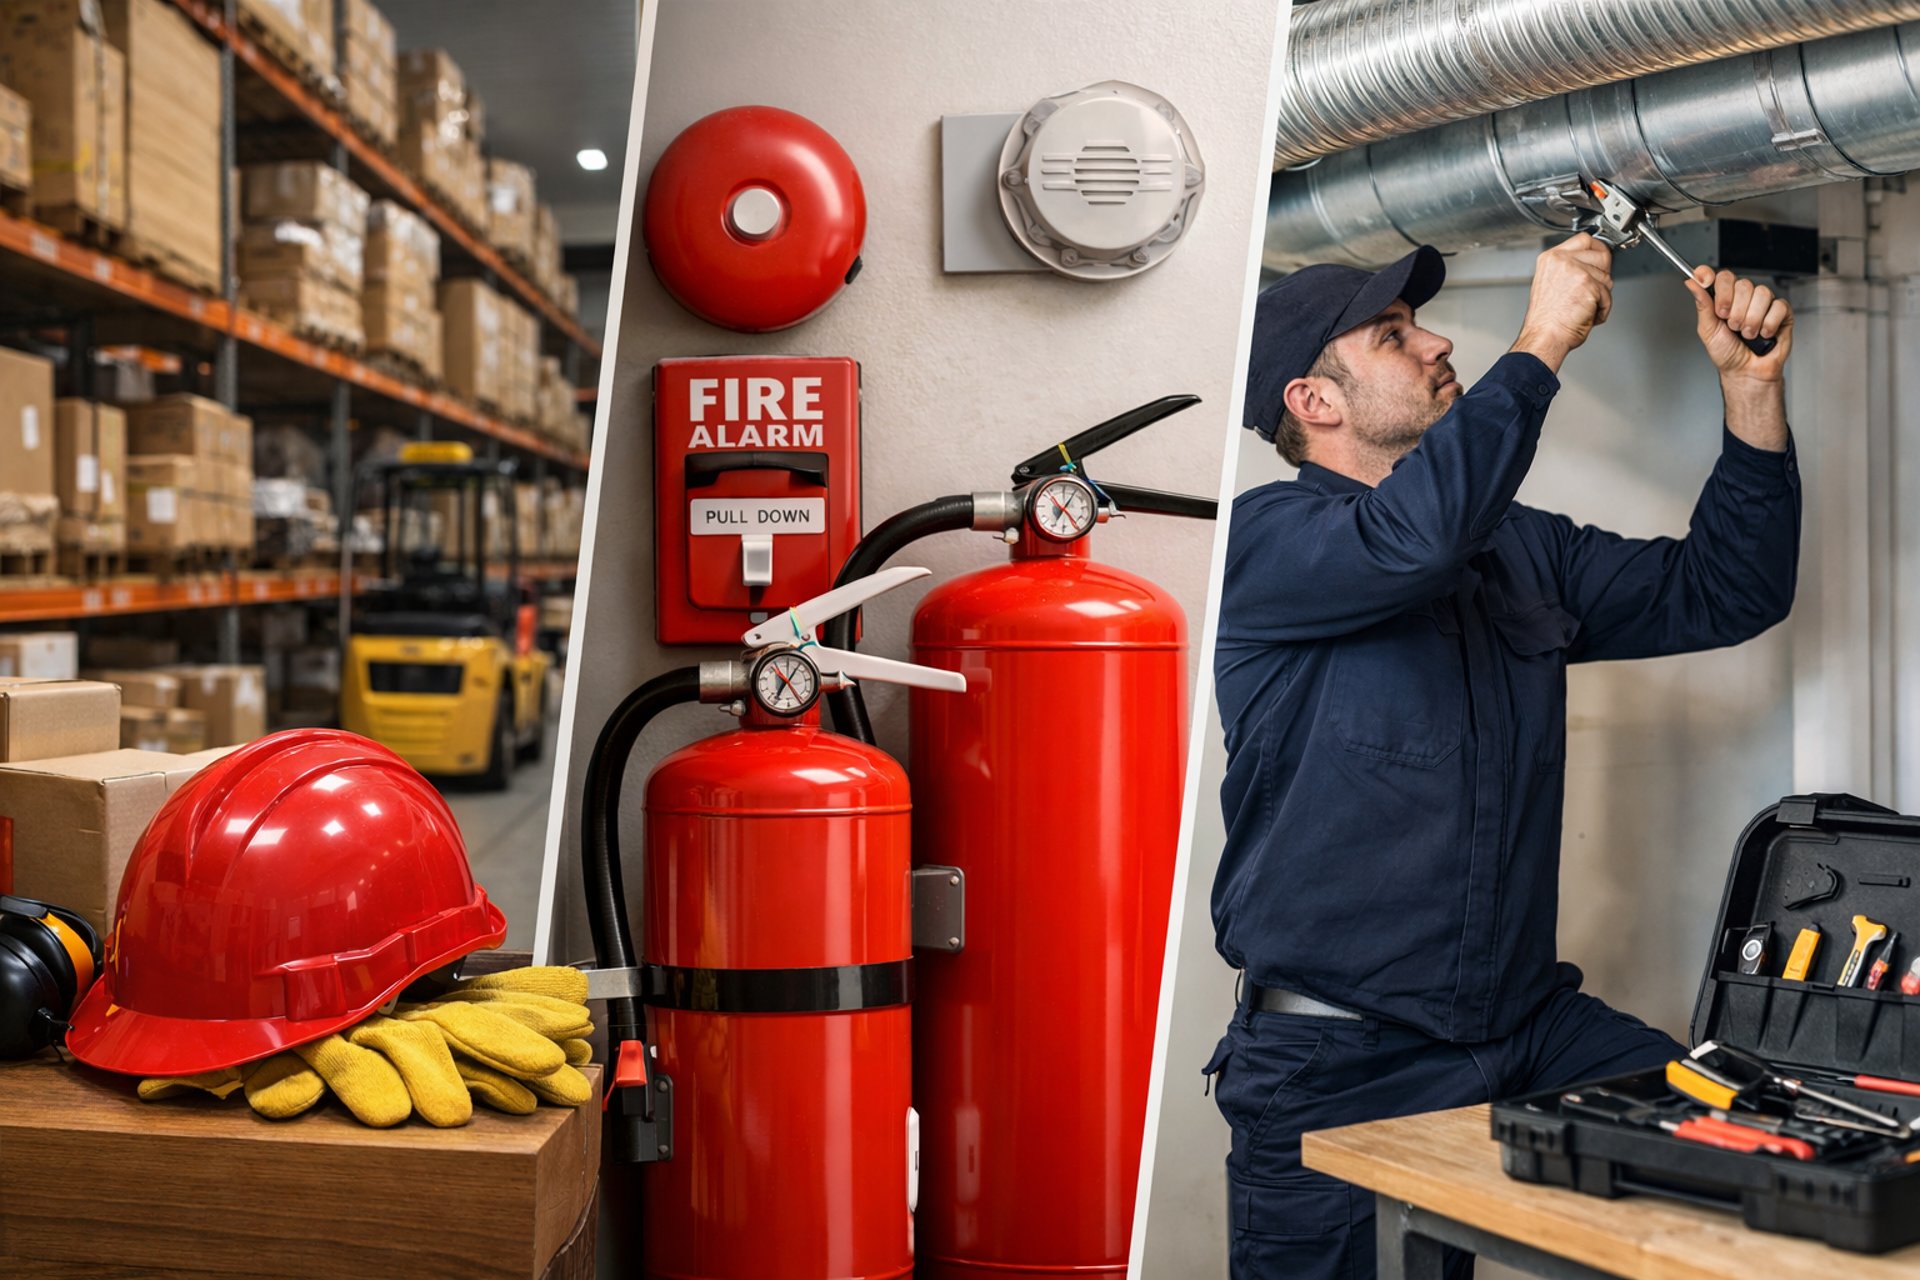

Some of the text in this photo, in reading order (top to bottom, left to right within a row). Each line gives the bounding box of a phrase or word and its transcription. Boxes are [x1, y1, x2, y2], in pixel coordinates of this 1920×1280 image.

[689, 377, 823, 422] FIRE
[688, 424, 823, 448] ALARM
[706, 509, 810, 524] PULL DOWN
